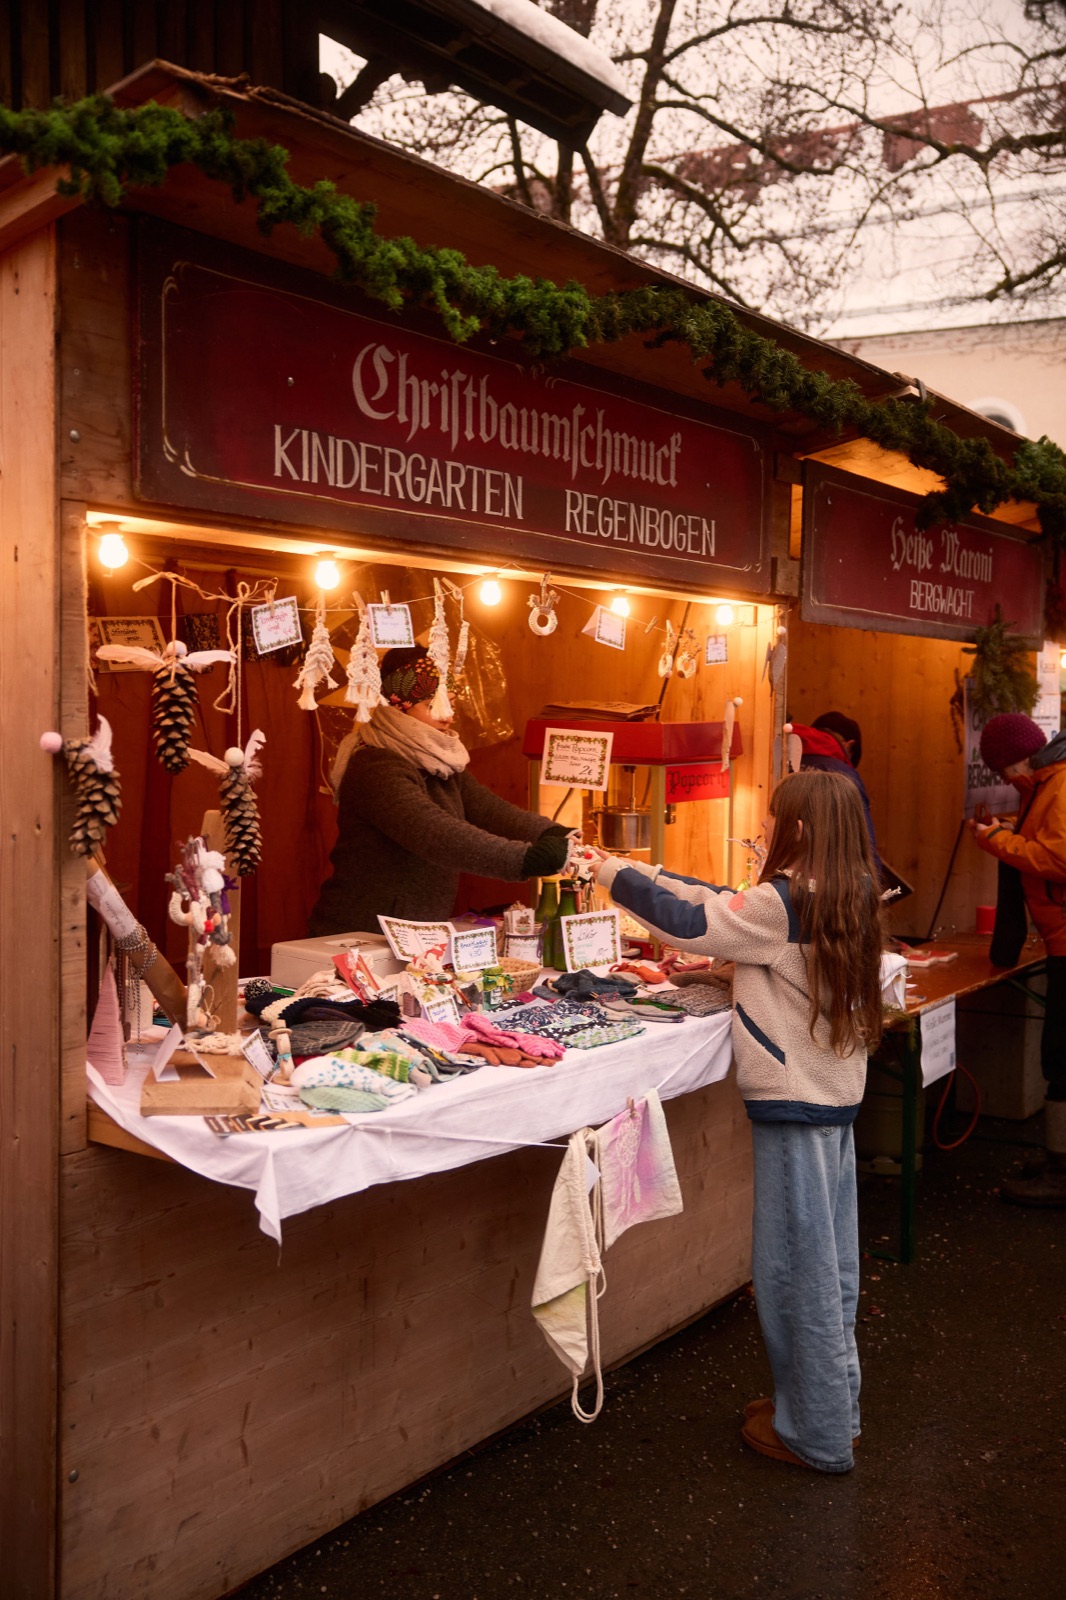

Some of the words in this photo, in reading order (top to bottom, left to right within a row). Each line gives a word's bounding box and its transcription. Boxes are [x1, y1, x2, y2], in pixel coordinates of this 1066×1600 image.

[273, 424, 525, 521] KINDERGARTEN
[565, 489, 717, 558] REGENBOGEN
[939, 529, 994, 583] Maroni
[909, 579, 975, 618] BERGWACHT
[667, 769, 727, 795] Popcorn
